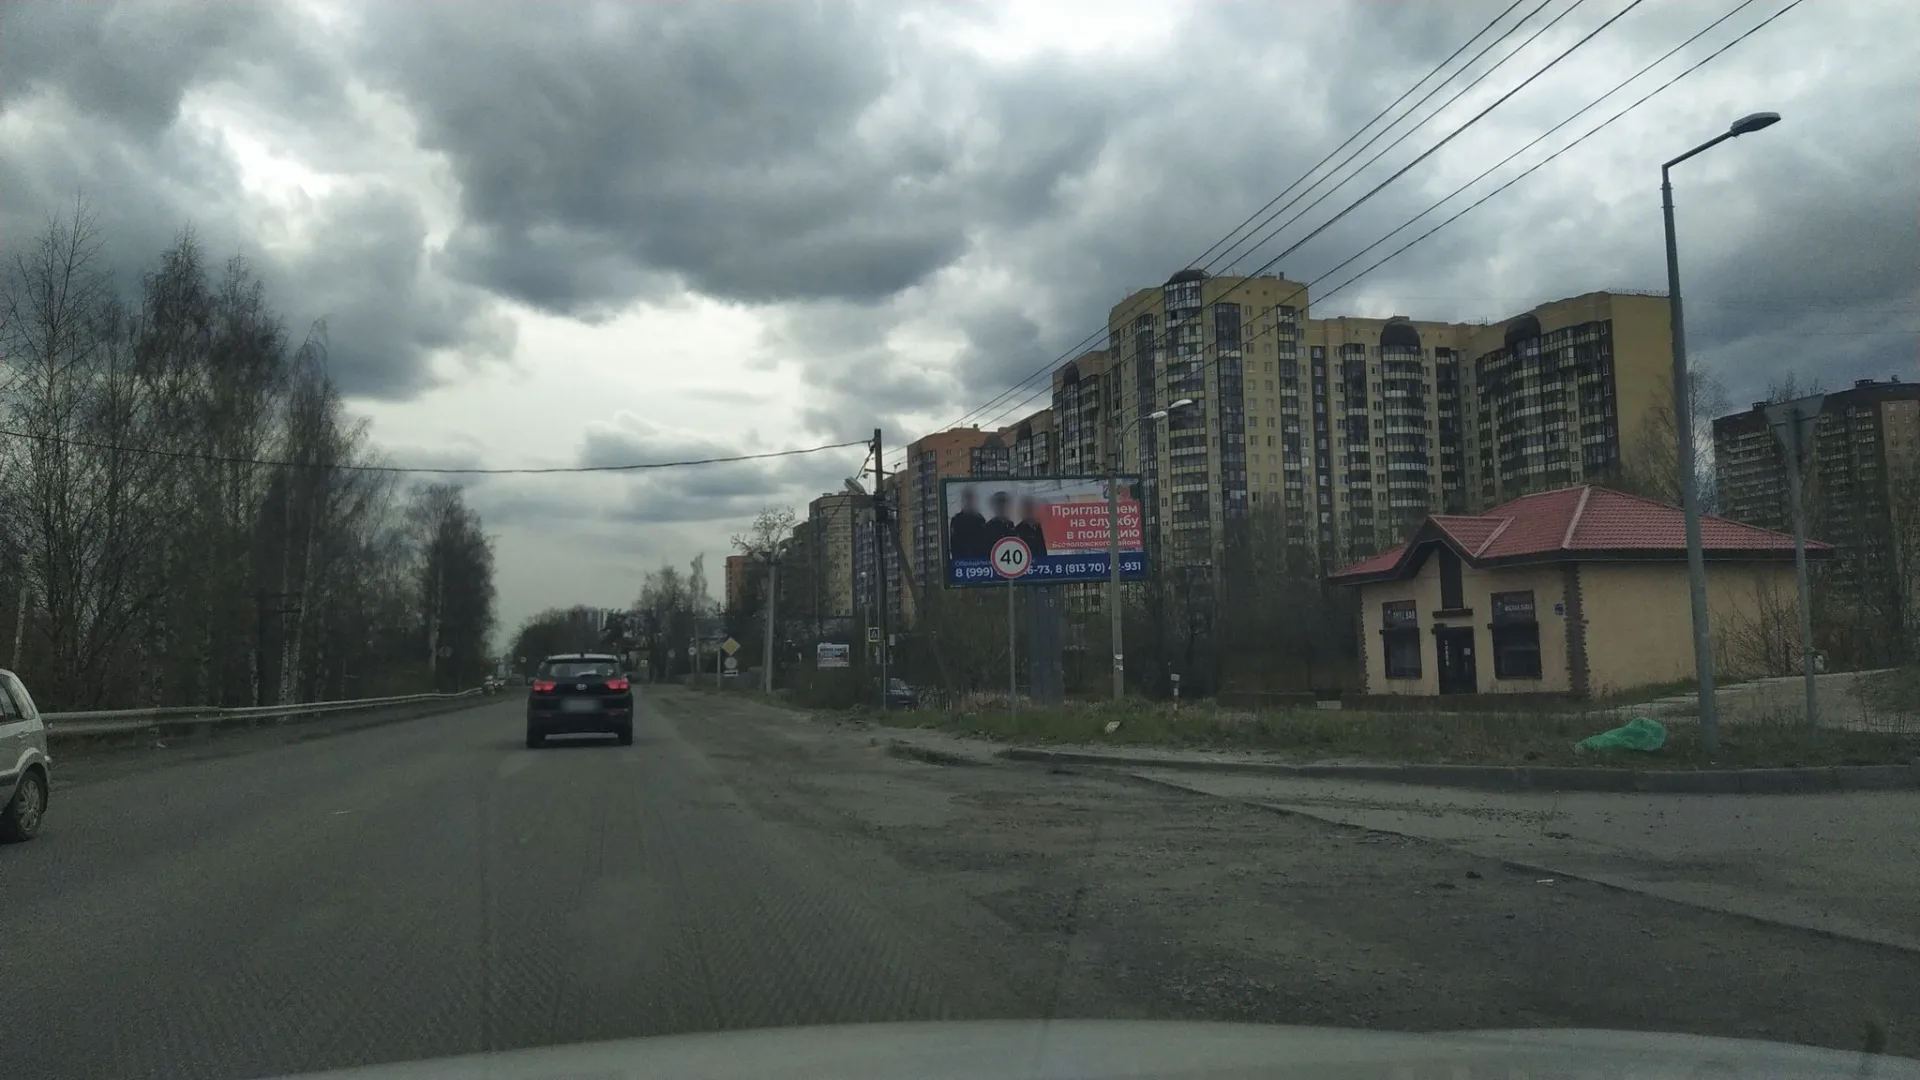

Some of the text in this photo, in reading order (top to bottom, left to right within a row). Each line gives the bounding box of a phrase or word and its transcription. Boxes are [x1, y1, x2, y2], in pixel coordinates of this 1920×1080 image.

[1070, 519, 1086, 527] на
[1066, 529, 1140, 540] в полиию
[1000, 549, 1023, 565] 40
[955, 568, 963, 577] 8
[966, 567, 993, 578] (999)
[1055, 564, 1063, 573] 8
[1065, 563, 1086, 575] (813
[1088, 563, 1105, 574] 70)
